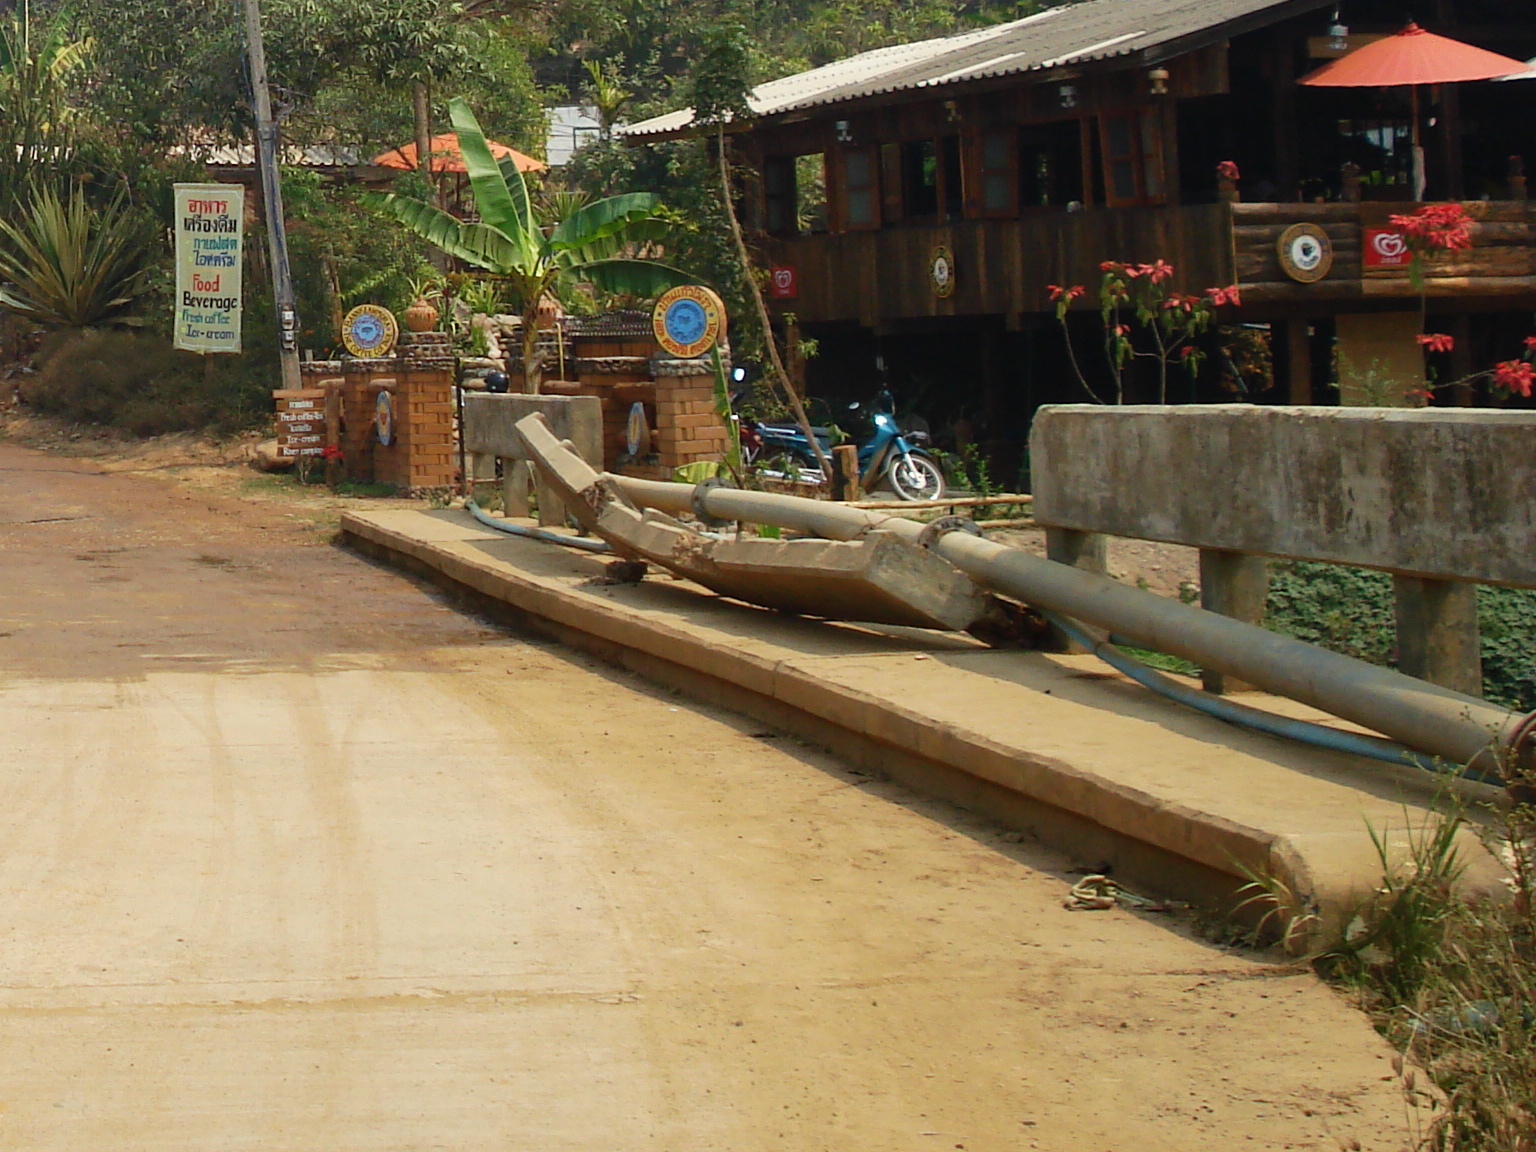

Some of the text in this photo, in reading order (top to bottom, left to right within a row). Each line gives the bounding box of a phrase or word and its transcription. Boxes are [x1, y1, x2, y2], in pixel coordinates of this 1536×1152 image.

[187, 199, 228, 214] อาหาร
[184, 213, 237, 233] เครื่องดื่ม
[193, 273, 220, 292] Food
[183, 291, 238, 312] Beverage
[182, 309, 230, 324] Fresh coffee
